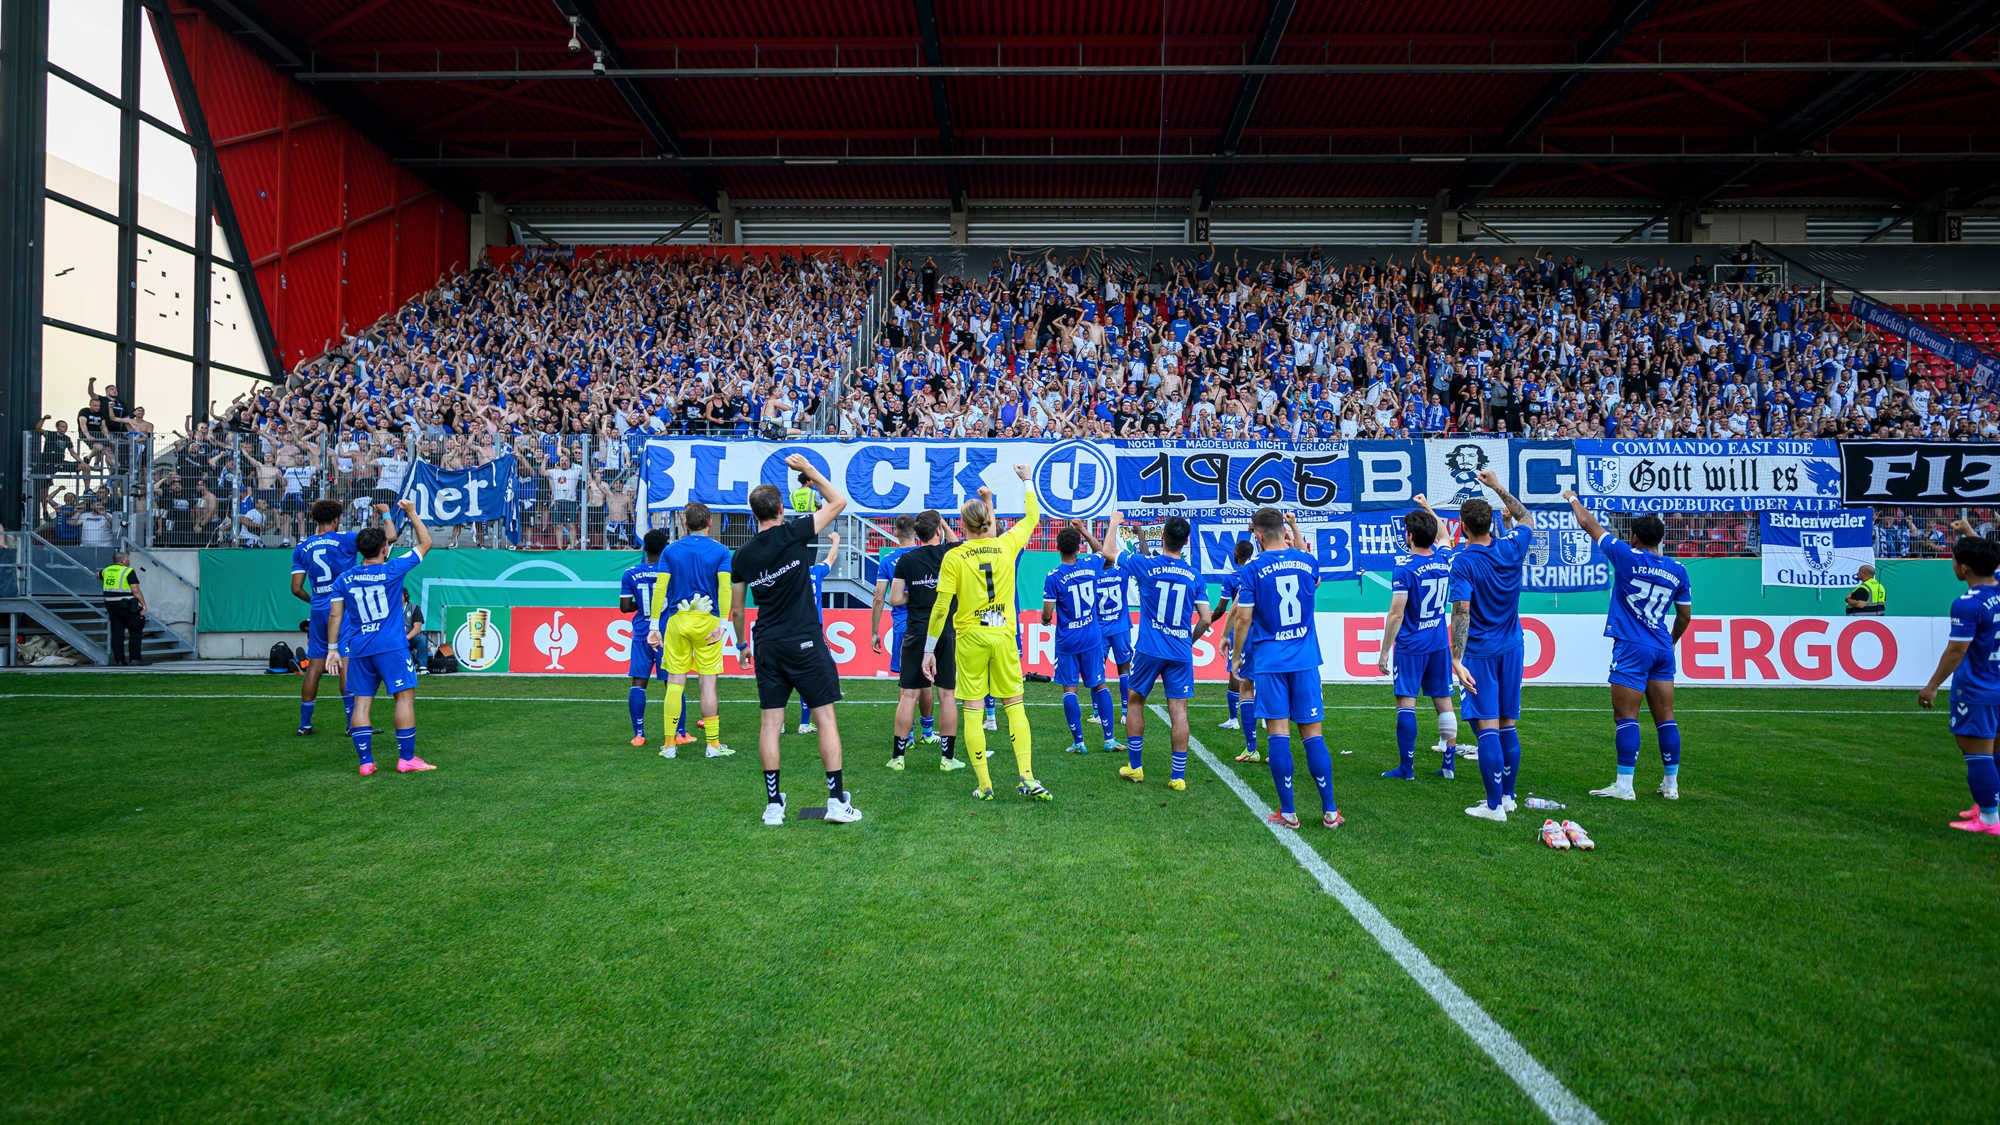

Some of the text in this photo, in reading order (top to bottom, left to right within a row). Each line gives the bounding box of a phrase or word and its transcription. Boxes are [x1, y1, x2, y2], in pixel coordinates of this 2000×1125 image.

[1198, 220, 1206, 228] N
[1199, 230, 1206, 239] 2
[1868, 308, 1906, 335] Kollektiv
[1128, 440, 1349, 451] NOCH IST MAGDEBURG NICHT VERLOREN
[1612, 442, 1814, 455] COMMANDO EAST SIDE
[1588, 460, 1616, 471] 1.FC
[1629, 458, 1798, 492] Gott will es
[647, 444, 998, 510] BLOCK
[1140, 451, 1339, 508] 1965
[1588, 472, 1618, 492] MAGDEBURG
[1128, 509, 1154, 517] NOCH
[1200, 509, 1216, 517] DIE
[1621, 498, 1735, 512] MAGDEBURG
[1741, 496, 1788, 510] ÜBER
[1770, 512, 1866, 528] Eichenweiler
[1804, 535, 1830, 547] 1.FC
[313, 549, 332, 582] 5
[1262, 565, 1272, 576] FC
[1272, 561, 1312, 574] MAGDEBURG
[1419, 566, 1426, 574] FC
[1804, 551, 1833, 569] MAGDEBURG
[912, 578, 938, 586] sockenka
[979, 563, 995, 603] 1
[1162, 566, 1195, 581] MAGDEBURG
[1522, 563, 1608, 587] IRANHAS
[1648, 567, 1680, 587] MAGDEBURG
[1777, 569, 1860, 585] Clubfans
[349, 584, 389, 624] 10
[1068, 580, 1095, 619] 19
[1097, 584, 1122, 614] 29
[1155, 581, 1186, 626] 11
[1275, 574, 1301, 626] 8
[1420, 577, 1449, 618] 24
[1626, 578, 1673, 622] 20
[1275, 626, 1307, 641] ARSLAN
[1680, 618, 1898, 682] ERGO
